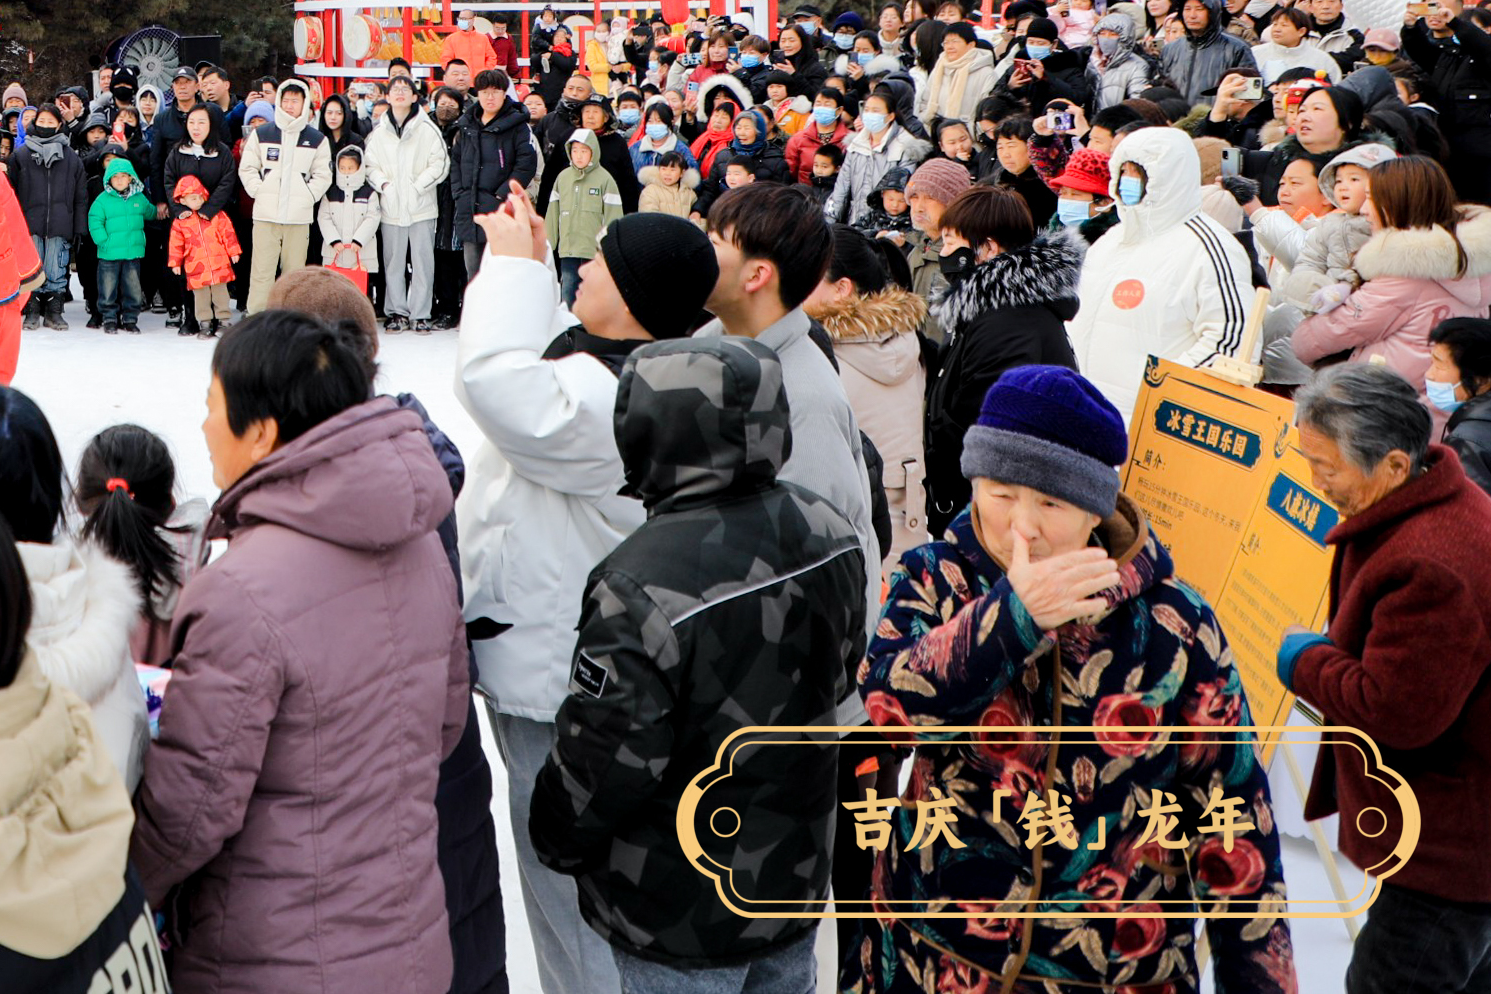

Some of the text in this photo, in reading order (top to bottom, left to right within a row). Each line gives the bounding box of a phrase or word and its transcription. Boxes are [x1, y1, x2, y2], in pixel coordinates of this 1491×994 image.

[1166, 409, 1248, 459] 冰雪王国乐园
